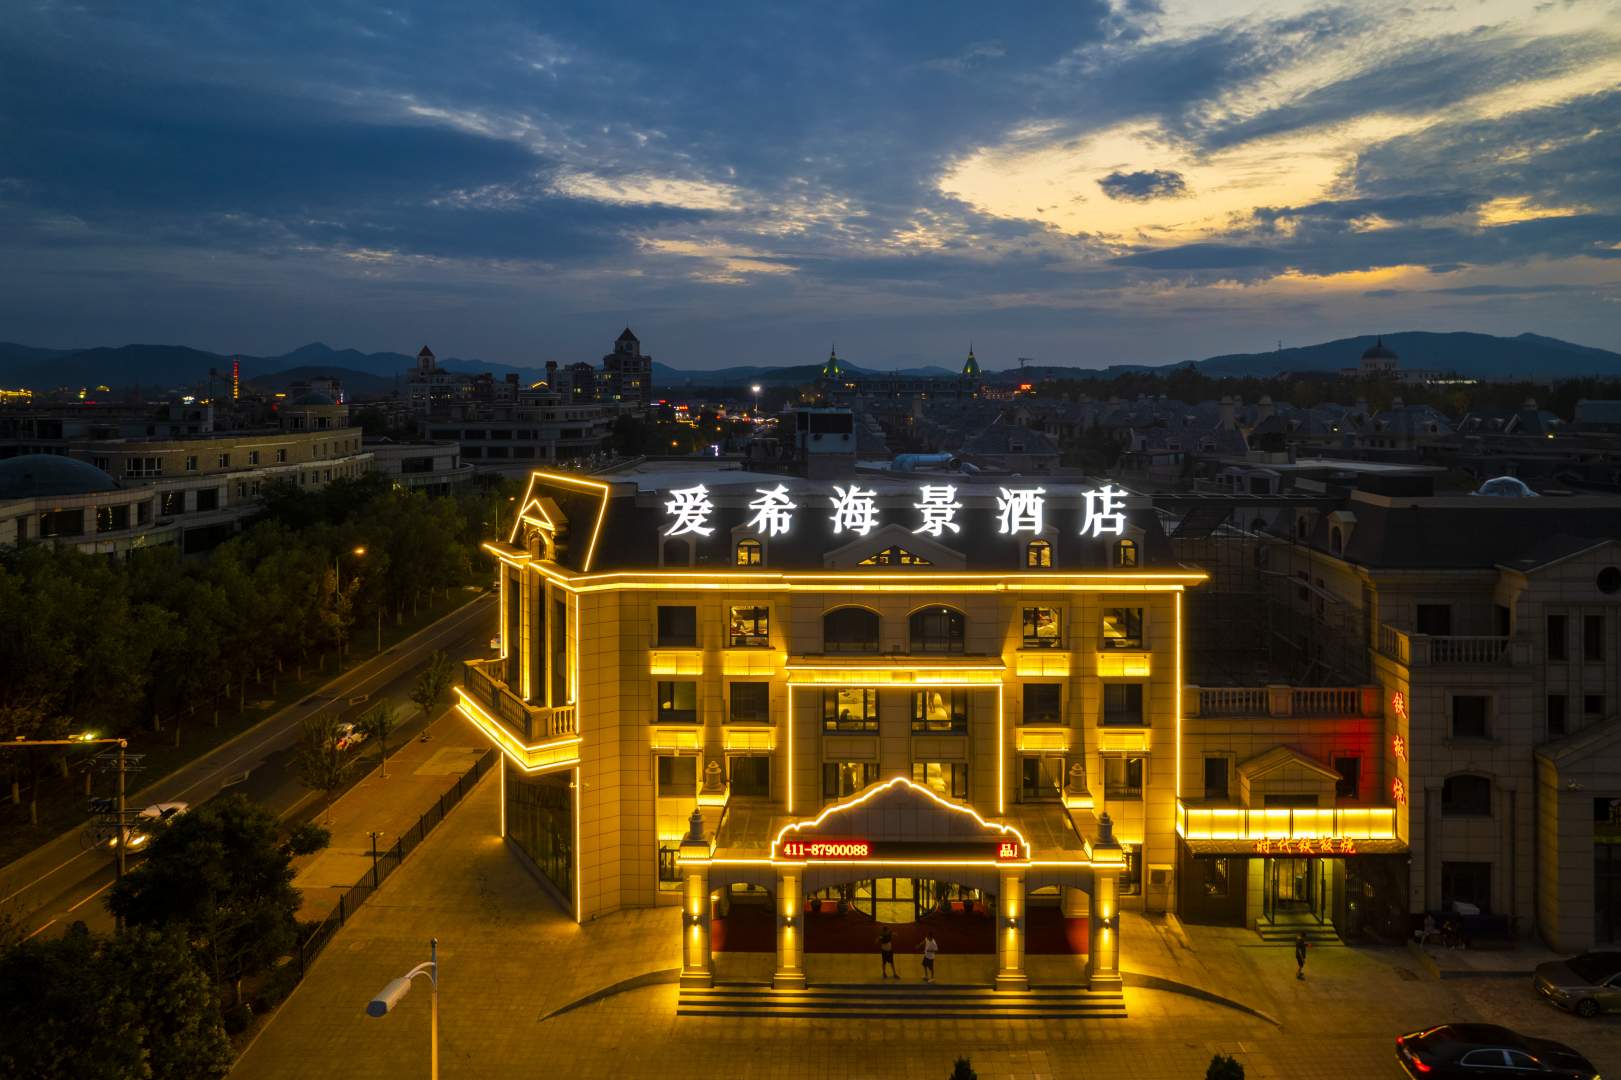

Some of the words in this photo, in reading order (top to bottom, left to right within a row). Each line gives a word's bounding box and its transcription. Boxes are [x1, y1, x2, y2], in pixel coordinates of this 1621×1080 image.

[664, 484, 1129, 537] 爱希海景酒店
[783, 844, 868, 857] 411-87900088
